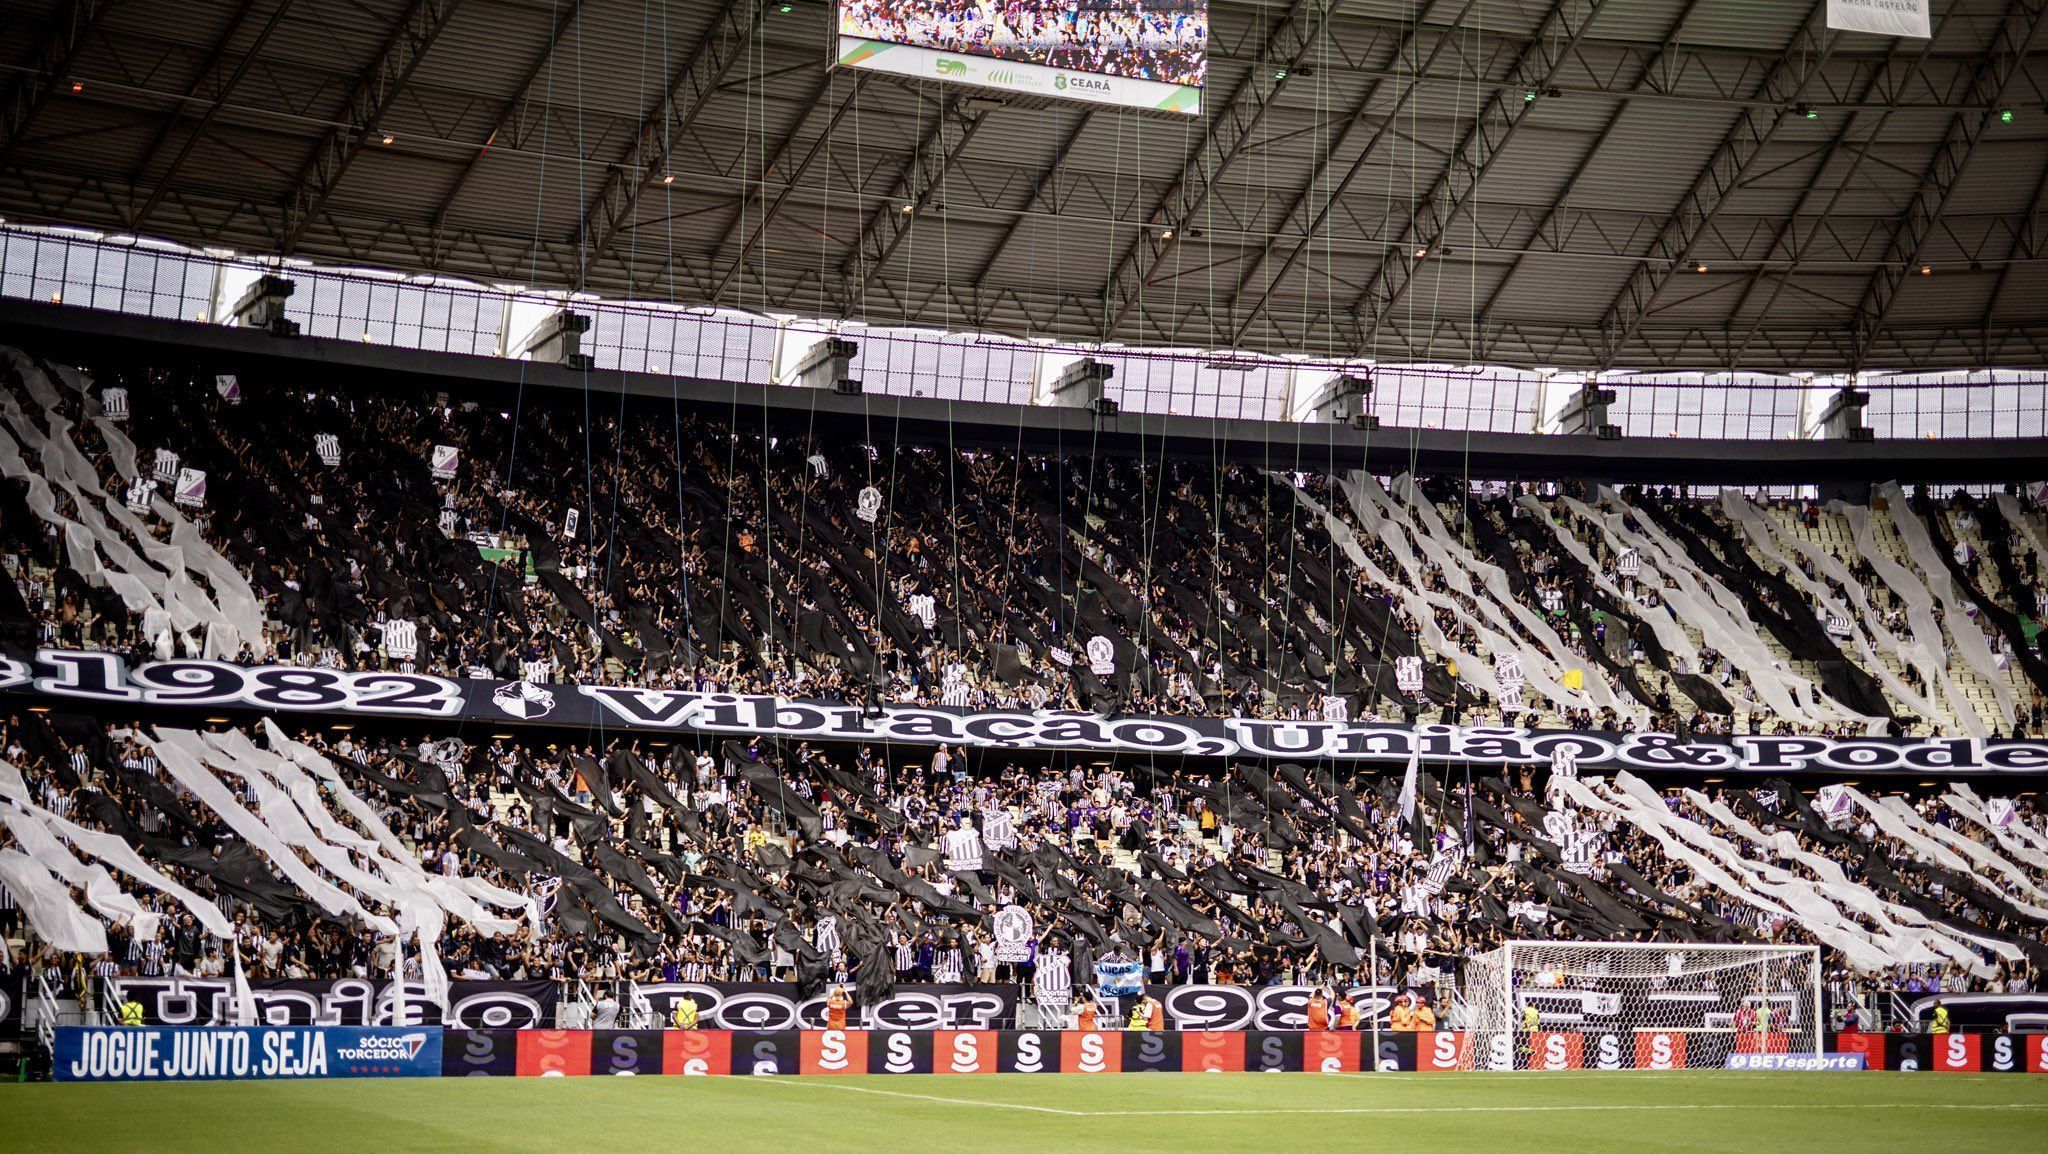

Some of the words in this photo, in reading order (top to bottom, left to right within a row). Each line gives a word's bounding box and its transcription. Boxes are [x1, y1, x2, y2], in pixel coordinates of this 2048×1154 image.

[1070, 78, 1110, 91] CEARÁ
[38, 649, 463, 715] 1982
[588, 687, 1235, 757] Vibração,
[1234, 719, 1611, 763] União
[1622, 735, 1736, 768] &
[1566, 838, 1585, 856] CSC
[1099, 965, 1132, 975] LUCAS
[72, 1032, 159, 1077] JOGUE
[262, 1031, 327, 1076] SEJA
[338, 1049, 407, 1060] TORCEDOR
[360, 1035, 403, 1048] SÓCIO
[887, 1032, 912, 1064] S
[953, 1033, 978, 1063] S
[1017, 1033, 1041, 1063] S
[1080, 1033, 1104, 1063] S
[1434, 1032, 1456, 1060] S
[1948, 1034, 1965, 1059] S
[1995, 1036, 2012, 1061] S
[1749, 1056, 1858, 1070] BETesporte
